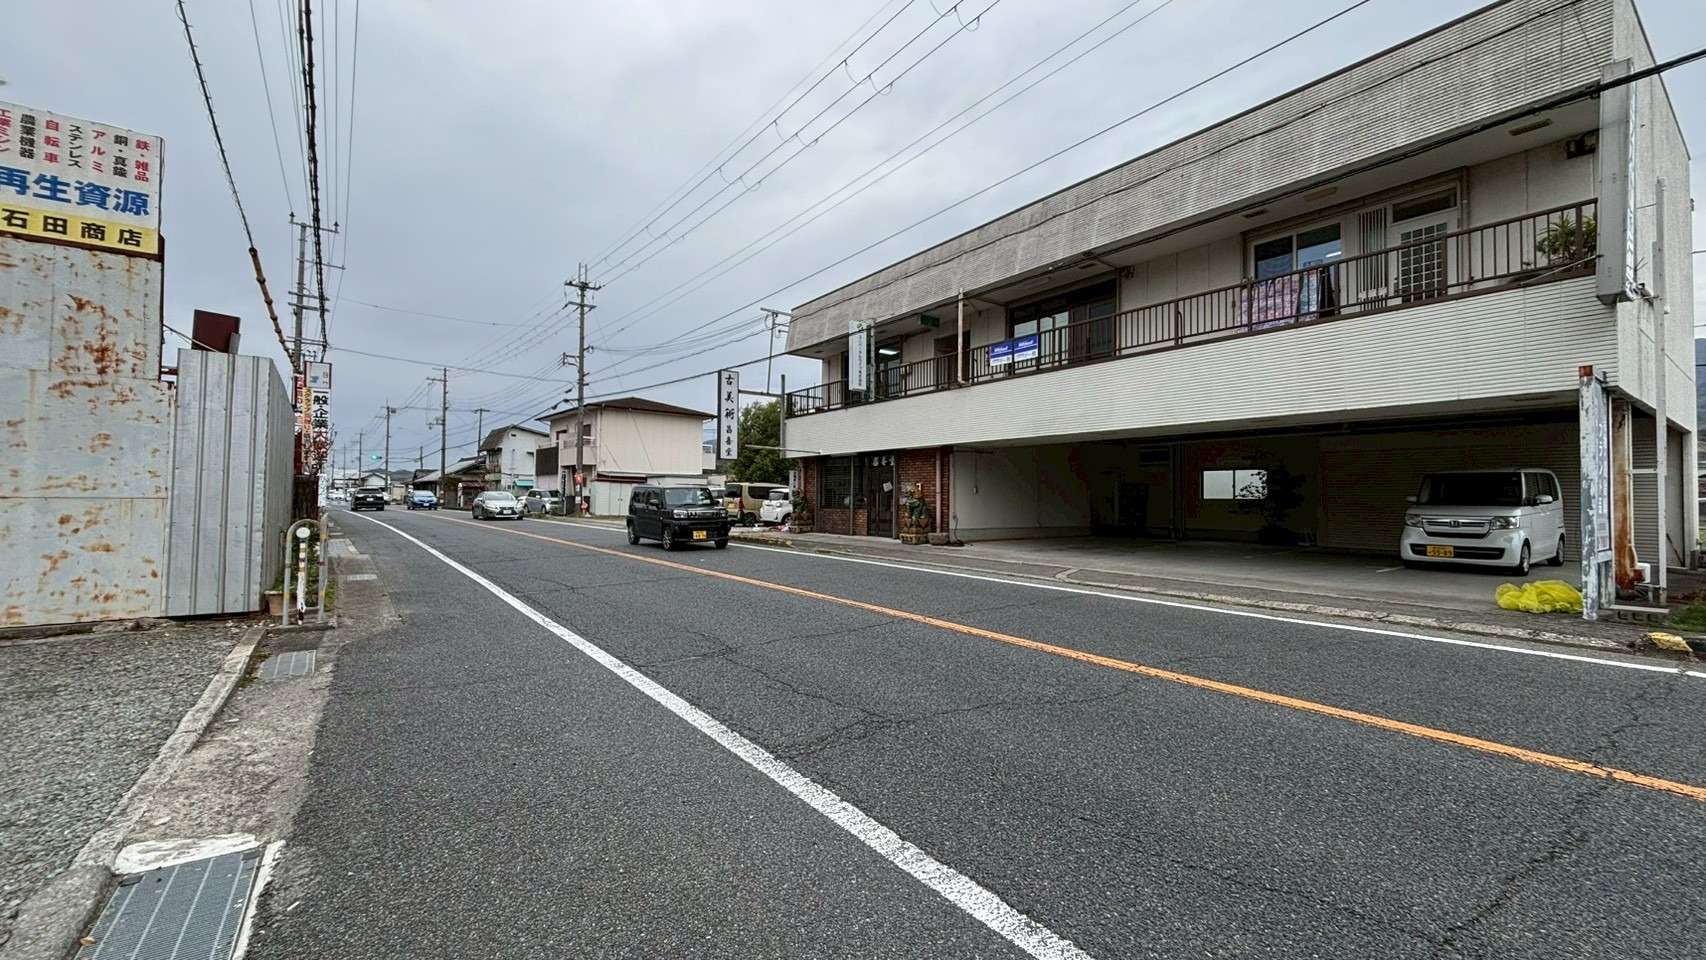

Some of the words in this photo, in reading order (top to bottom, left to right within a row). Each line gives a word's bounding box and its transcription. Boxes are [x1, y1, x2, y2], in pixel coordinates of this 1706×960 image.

[19, 113, 36, 160] 農業機器
[43, 119, 60, 164] 自転車
[68, 124, 83, 169] ステンレス
[91, 129, 106, 173] アルミ
[0, 165, 150, 217] 再生資源
[1, 208, 143, 248] 石田商店
